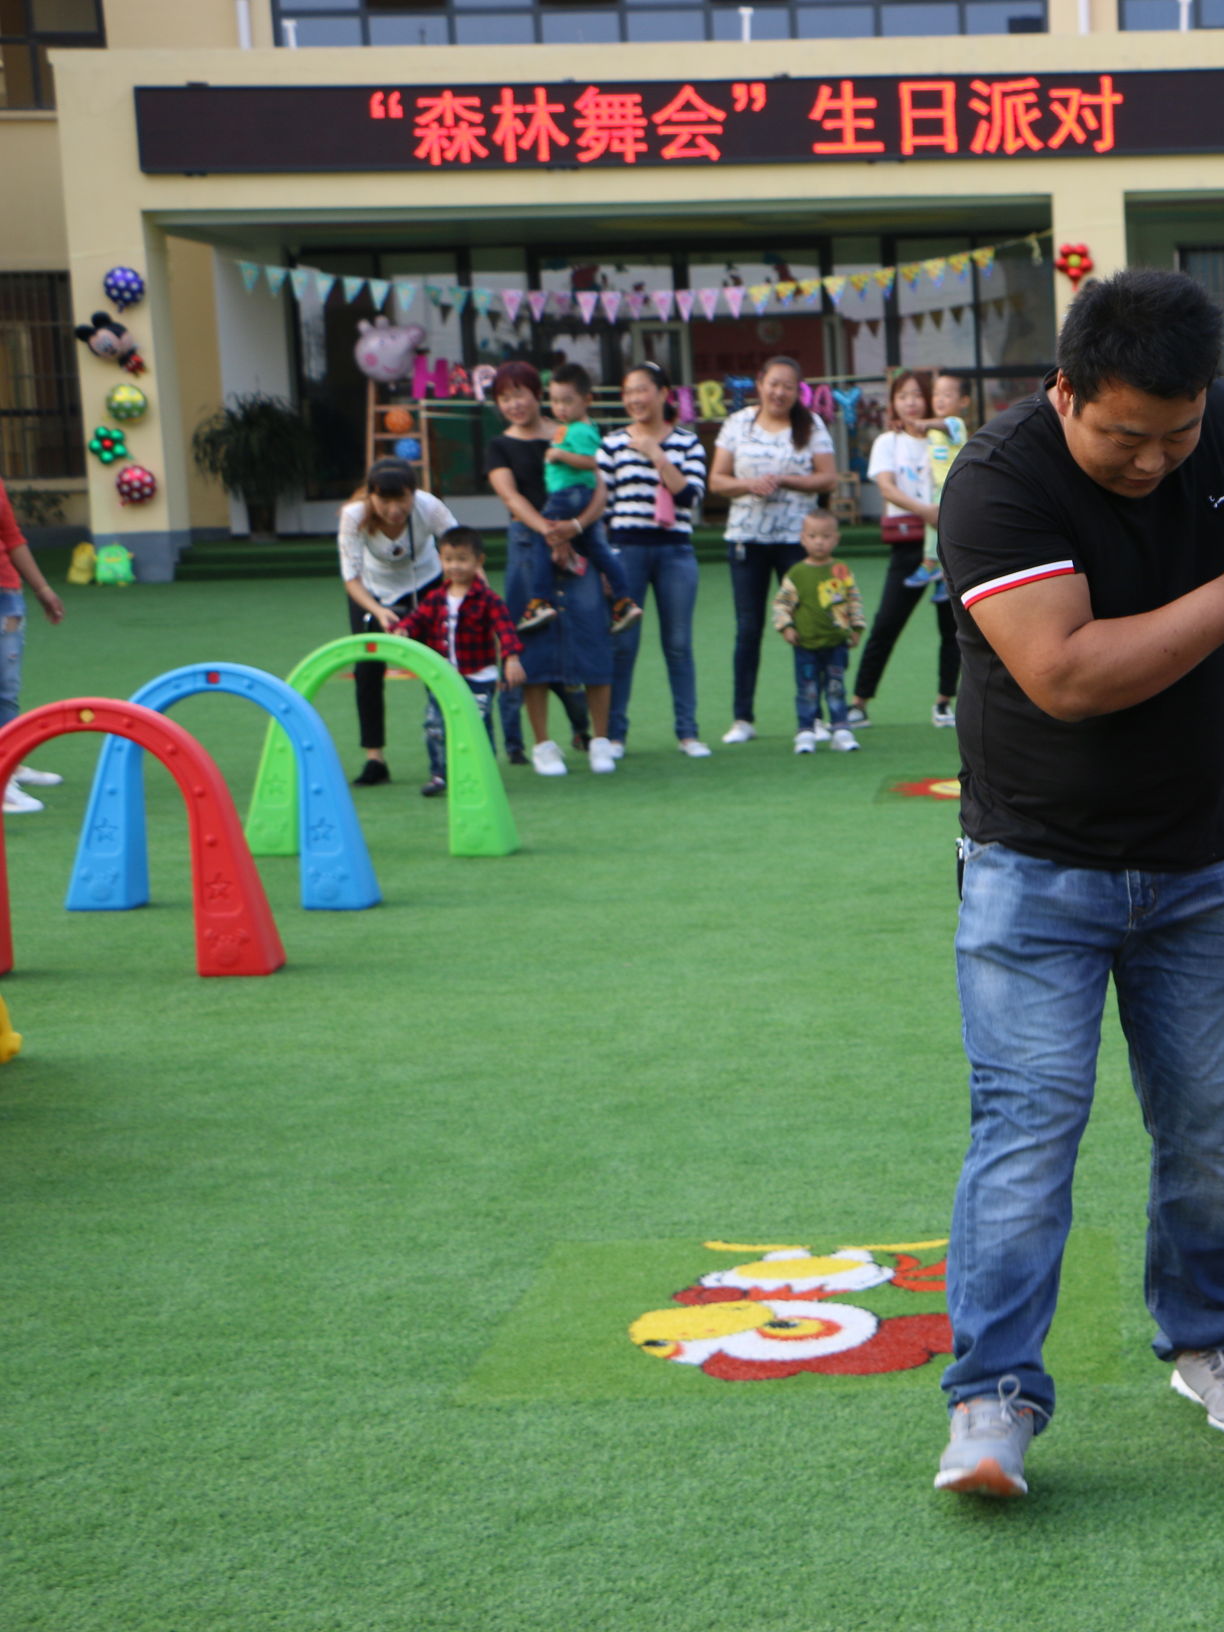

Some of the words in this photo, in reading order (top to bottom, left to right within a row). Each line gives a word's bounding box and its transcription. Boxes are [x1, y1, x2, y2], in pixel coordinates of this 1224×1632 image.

[369, 83, 767, 166] “森林舞会”
[808, 75, 1124, 155] 生日派对
[411, 353, 553, 401] HAP
